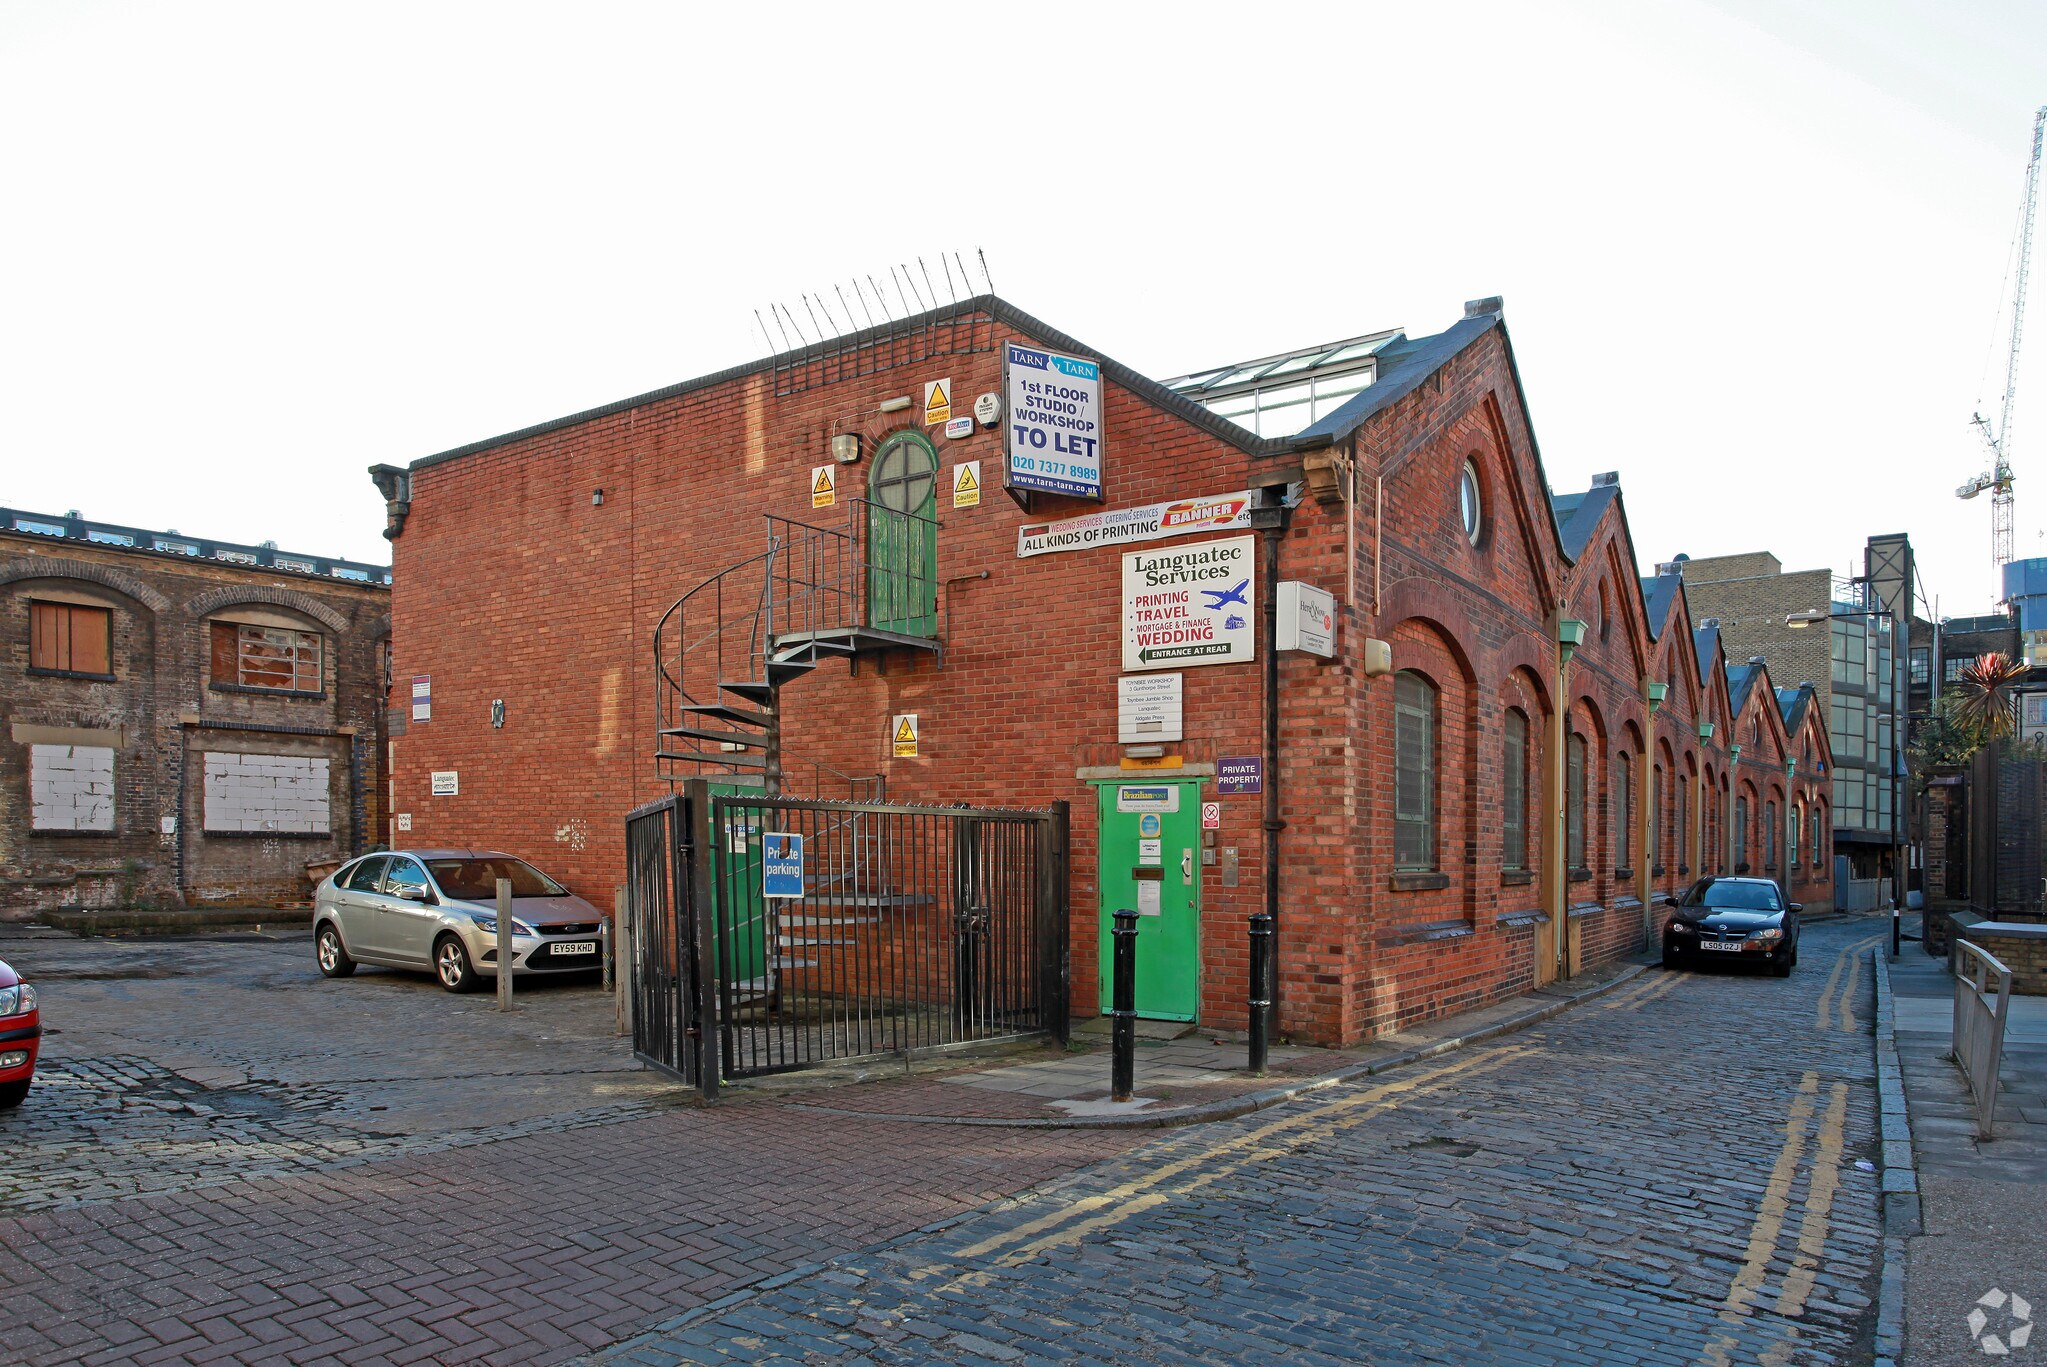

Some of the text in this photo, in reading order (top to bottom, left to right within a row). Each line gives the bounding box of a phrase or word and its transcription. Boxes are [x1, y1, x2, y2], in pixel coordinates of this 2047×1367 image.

[1012, 350, 1043, 366] TARN
[1064, 361, 1093, 377] TARN
[1021, 380, 1089, 403] 1st FLOOR
[928, 410, 948, 418] Caution
[1026, 395, 1077, 415] STUDIO
[1016, 408, 1094, 432] WORKSHOP
[1013, 425, 1096, 457] TO LET
[1013, 456, 1097, 480] 020 7377 8989
[1013, 474, 1098, 494] www.tarn-tarn.co.uk
[1050, 522, 1076, 533] WEDDING
[1076, 516, 1103, 528] SERVICES
[1105, 512, 1132, 524] CATERING
[1133, 508, 1158, 520] SERVICES
[1170, 504, 1232, 525] BANNER
[1024, 520, 1158, 551] ALL KINDS OF PRINTING
[1134, 547, 1241, 572] Languatec
[1146, 565, 1230, 587] Services
[1136, 591, 1189, 607] PRINTING
[1136, 606, 1189, 622] TRAVEL
[1136, 622, 1172, 633] MORTGAGE
[1182, 618, 1211, 628] FINANCE
[1137, 627, 1213, 646] WEDDING
[1152, 648, 1192, 658] ENTRANCE
[1222, 765, 1256, 774] PRIVATE
[1219, 775, 1260, 784] PROPERTY
[768, 847, 798, 860] Prite
[767, 863, 800, 878] parking
[554, 944, 592, 953] EY59 KHD
[1703, 942, 1723, 950] LS05
